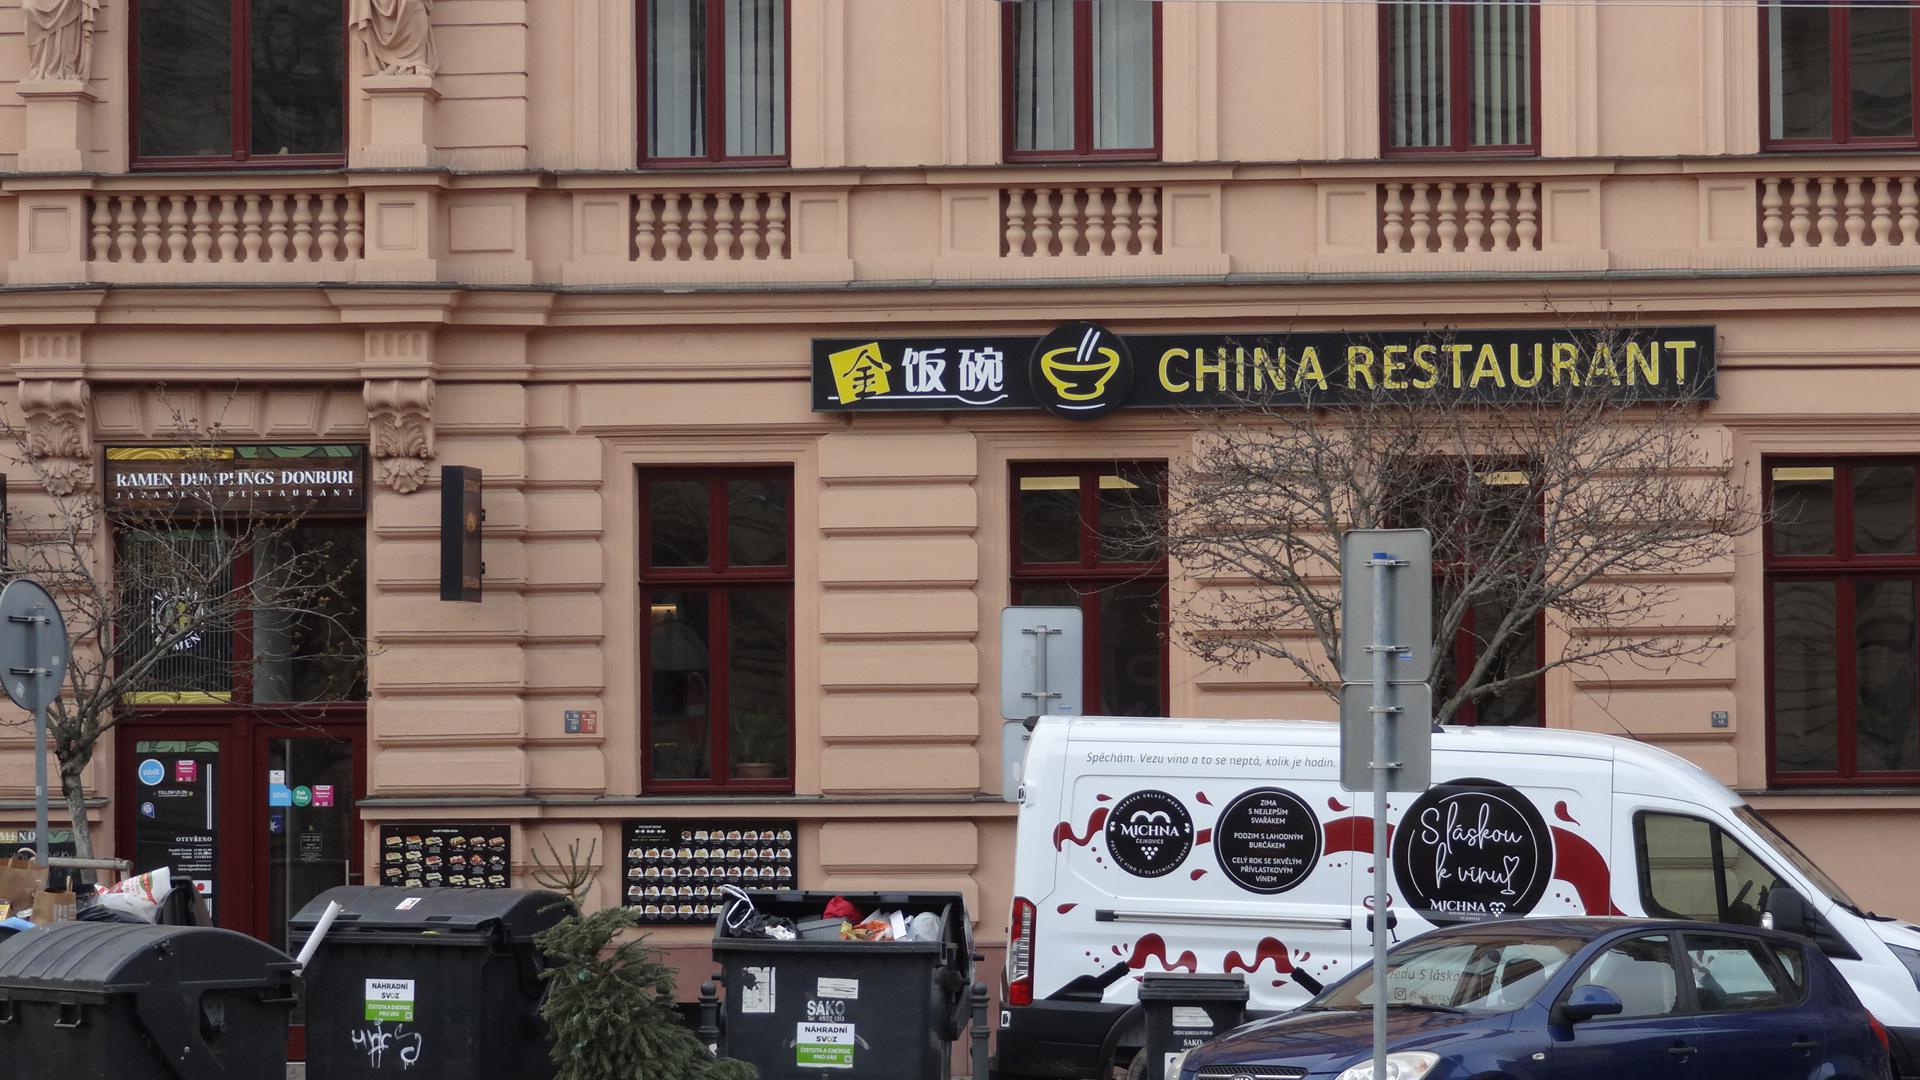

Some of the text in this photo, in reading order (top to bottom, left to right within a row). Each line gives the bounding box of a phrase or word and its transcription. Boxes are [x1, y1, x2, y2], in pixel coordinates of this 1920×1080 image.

[1158, 340, 1696, 393] CHINA RESTAURANT
[843, 347, 1004, 399] 金饭碗
[116, 472, 173, 487] RAMEN
[281, 470, 354, 486] DONBURI
[228, 488, 354, 498] RESTAURANT
[1086, 752, 1135, 765] Spěchám.
[1140, 753, 1164, 764] Vezu
[1167, 754, 1189, 764] víno
[1201, 755, 1213, 765] to
[1215, 756, 1226, 765] se
[1229, 755, 1262, 767] neptá,
[1265, 756, 1289, 767] kolik
[1291, 756, 1302, 769] je
[1304, 756, 1336, 768] hodin.
[1254, 807, 1288, 815] NEJLEPŠÍM
[1251, 816, 1286, 824] SVAŘÁKEM
[1120, 823, 1180, 838] MICHNA
[1420, 801, 1523, 855] S láskou
[1266, 832, 1303, 840] LAHODNÝM
[1249, 841, 1286, 849] BURČÁKEM
[1232, 856, 1248, 864] CELÝ
[1273, 857, 1302, 865] SKVĚLÝM
[1435, 842, 1508, 889] k vínu
[1240, 865, 1293, 873] PŘÍVLASTKOVÝM
[1429, 898, 1486, 913] MICHNA
[1429, 967, 1460, 982] lásko
[371, 982, 408, 990] NÁHRADNÍ
[806, 999, 846, 1016] SAKO
[804, 1025, 848, 1034] NÁHRADNÍ
[816, 1035, 838, 1043] SVOZ
[1183, 1038, 1203, 1046] SAKO
